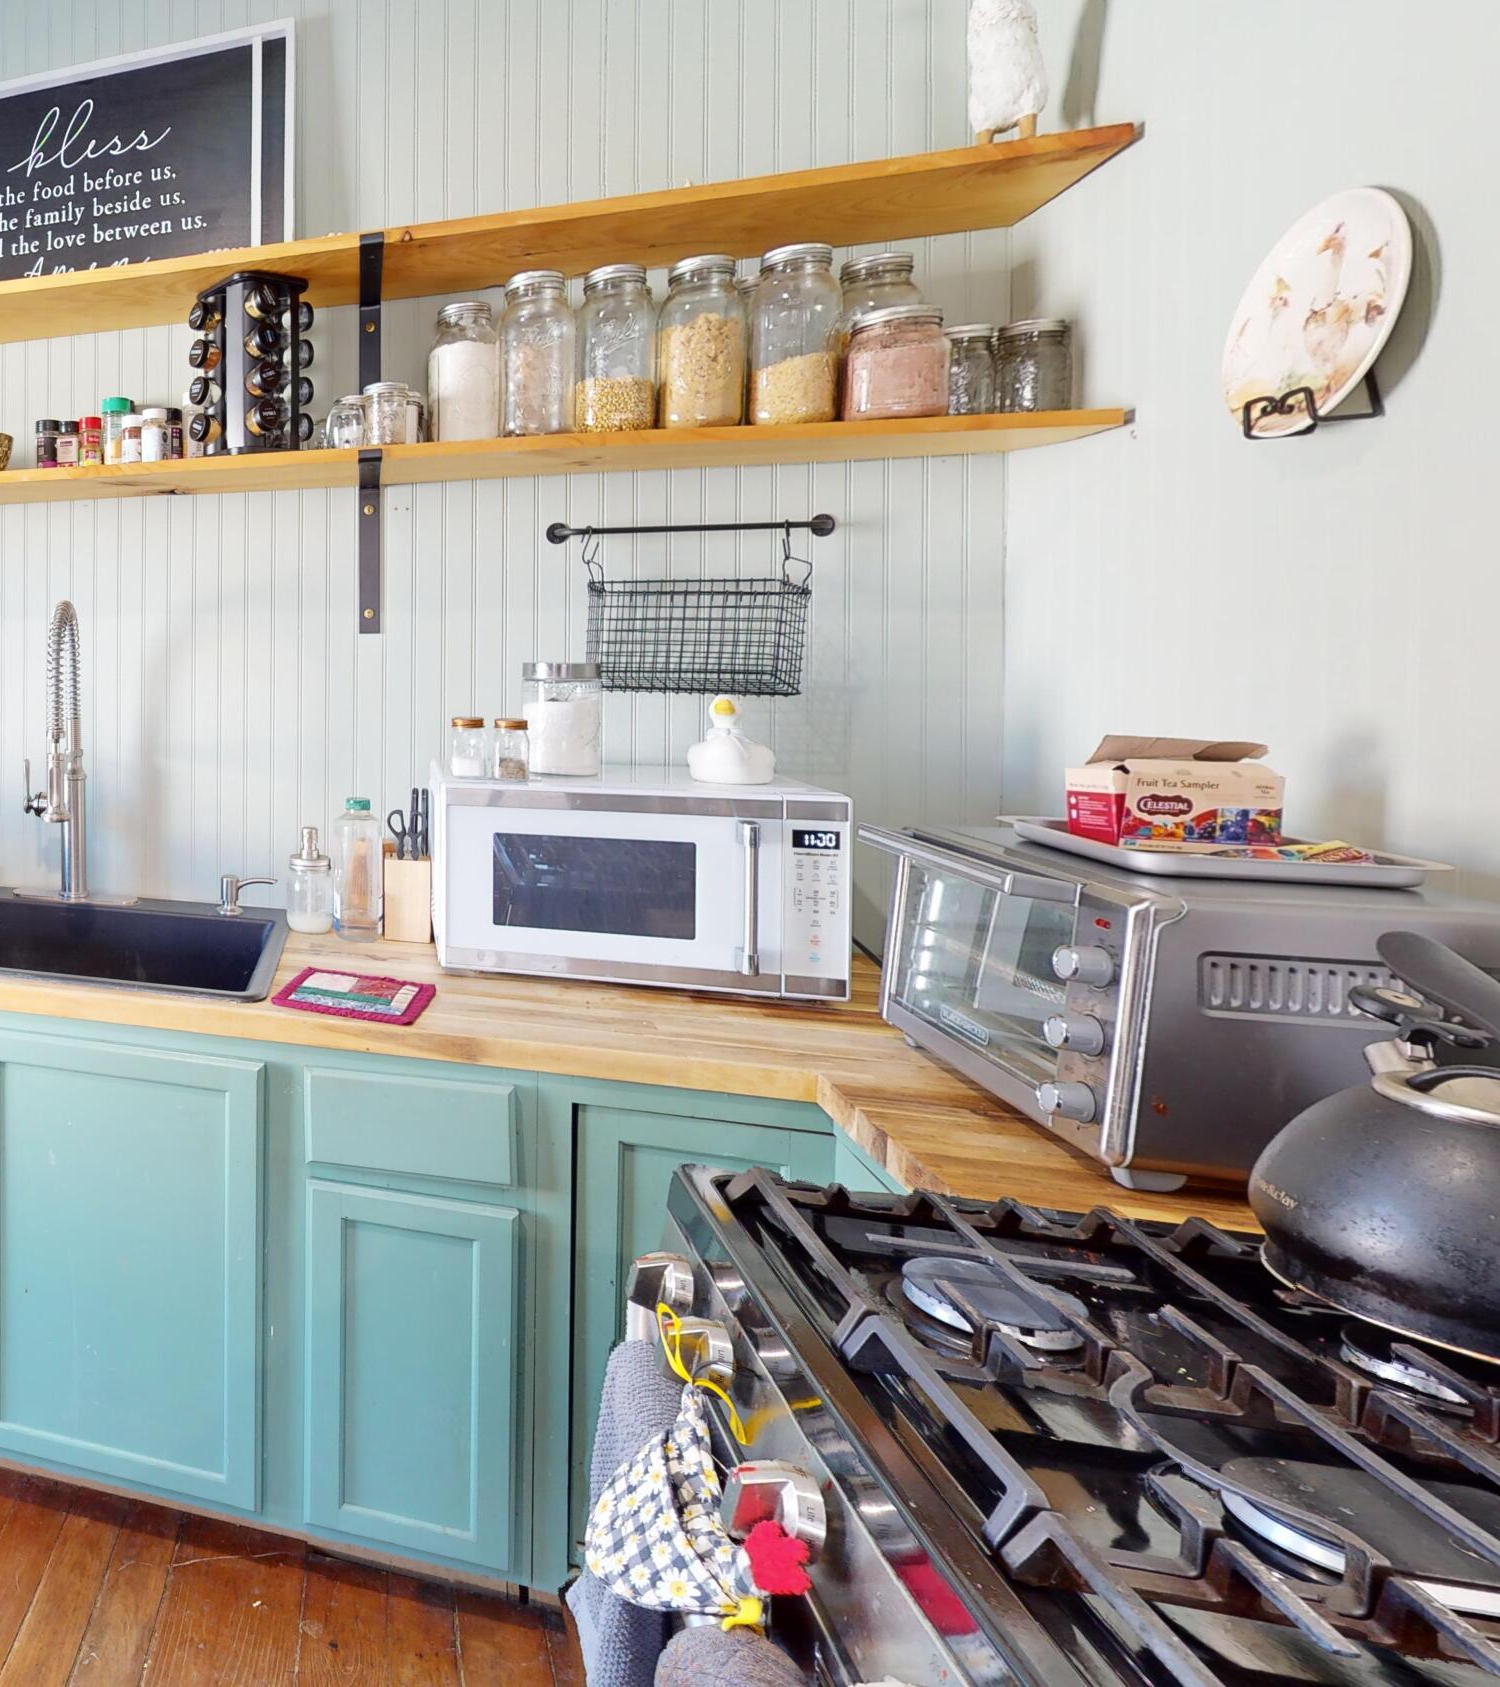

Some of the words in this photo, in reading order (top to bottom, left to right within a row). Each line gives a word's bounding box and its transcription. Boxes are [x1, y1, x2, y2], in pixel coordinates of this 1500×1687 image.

[7, 98, 172, 177] bless
[33, 174, 76, 202] food
[83, 168, 143, 193] before
[24, 201, 85, 229] family
[92, 190, 152, 218] beside
[11, 234, 40, 256] the
[46, 230, 86, 251] love
[93, 218, 172, 244] between
[180, 215, 208, 231] us.
[1136, 778, 1159, 788] Fruit
[1162, 778, 1178, 788] Tea
[1180, 779, 1220, 791] Sampler
[1139, 798, 1190, 811] CELESTIAL
